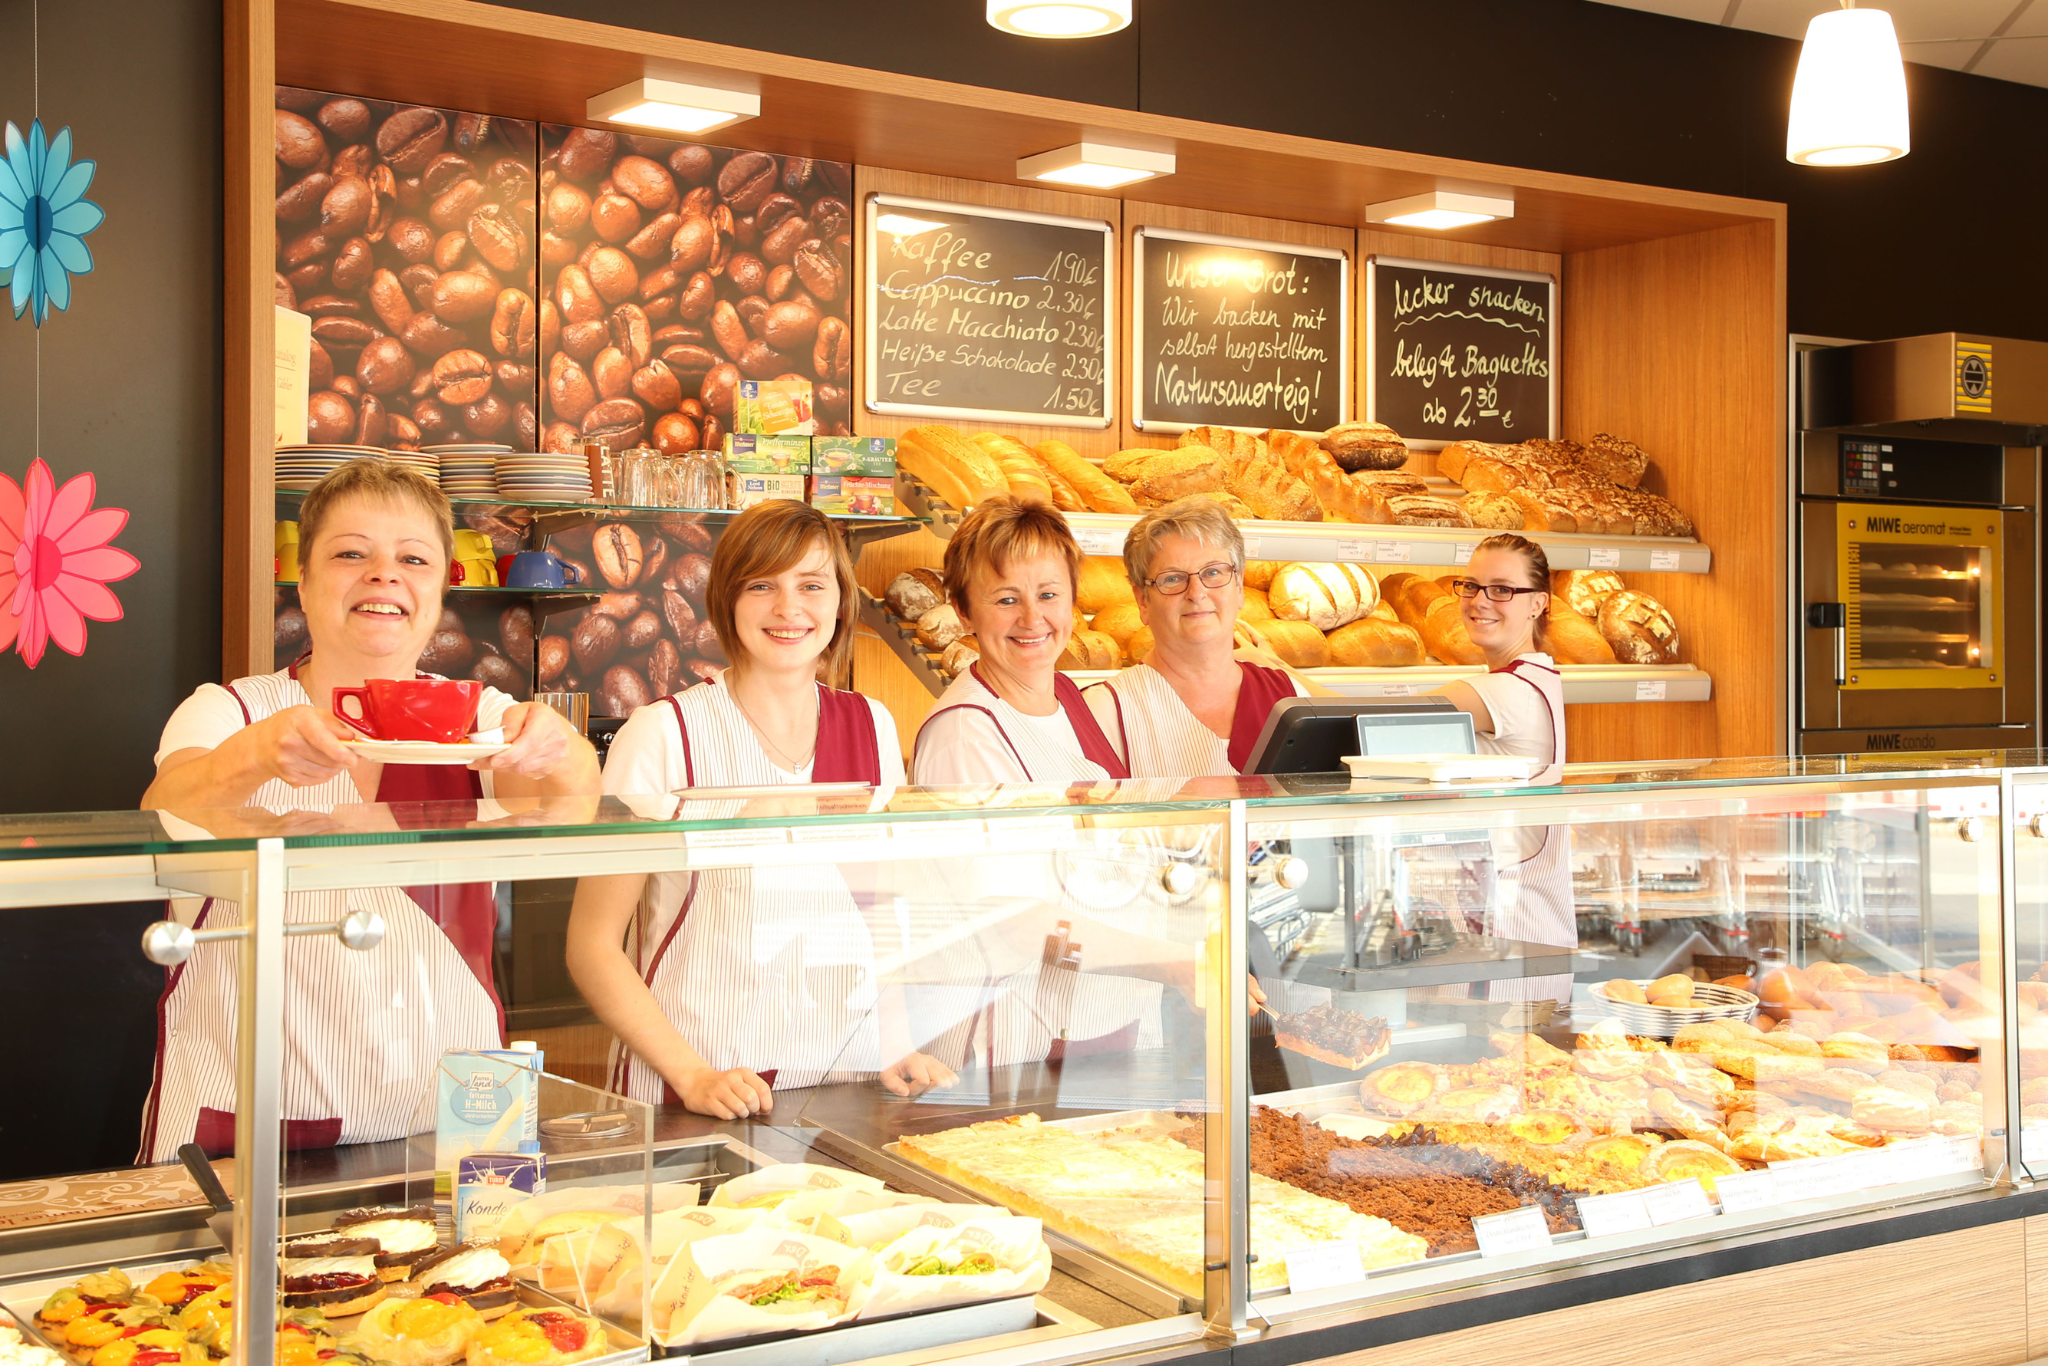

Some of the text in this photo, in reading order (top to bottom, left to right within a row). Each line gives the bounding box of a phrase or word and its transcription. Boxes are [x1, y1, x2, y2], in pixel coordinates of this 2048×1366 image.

[891, 232, 992, 274] Kaffee
[884, 270, 1030, 309] Cappuccino
[1394, 275, 1545, 323] lecker snacken
[879, 306, 938, 332] Latte
[947, 308, 1060, 343] Macchiato
[1162, 296, 1327, 332] Wir backen mit
[882, 339, 947, 368] Heiße
[951, 344, 1057, 376] Schokolade
[1160, 331, 1218, 358] selbst
[1461, 342, 1549, 388] Baguettes
[886, 370, 941, 397] Tee
[1155, 361, 1322, 424] Natursauerteig!
[1423, 397, 1447, 425] ab
[762, 437, 806, 447] Pfefferminze
[843, 481, 892, 490] Früchte-Mischung
[1867, 516, 1946, 535] MIWE aeromat
[1866, 733, 1936, 750] MIWE condo
[465, 1075, 493, 1091] Land
[465, 1099, 497, 1110] H-Milch
